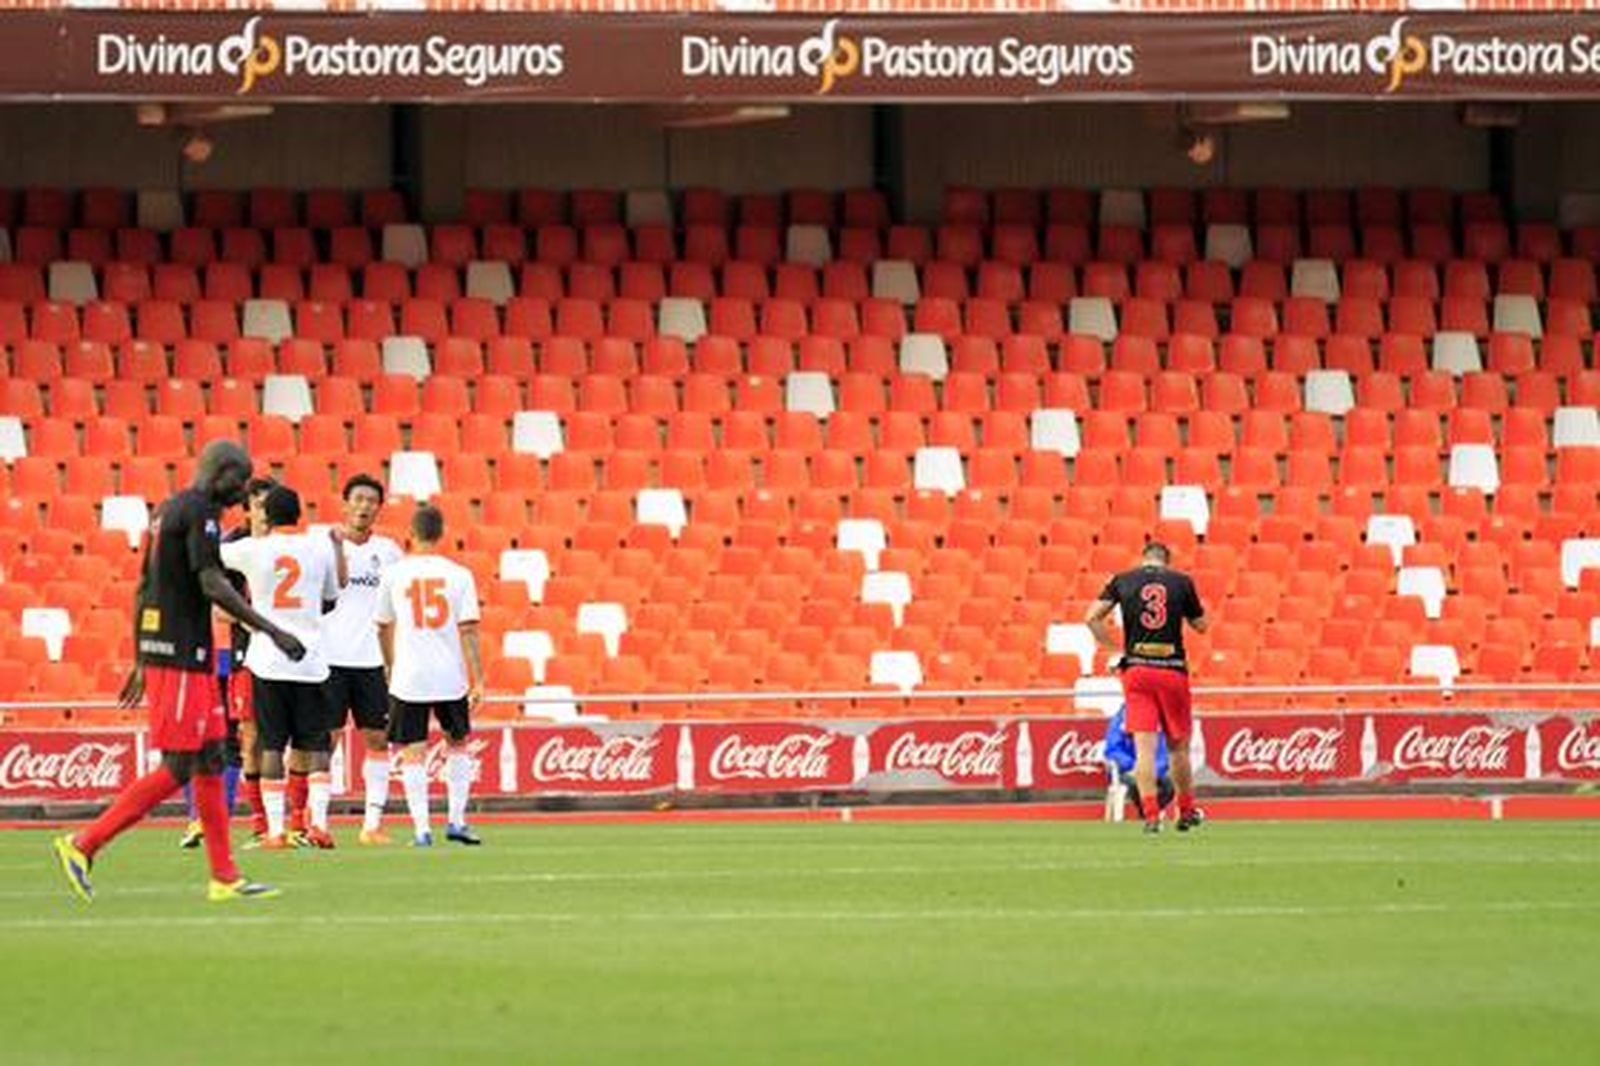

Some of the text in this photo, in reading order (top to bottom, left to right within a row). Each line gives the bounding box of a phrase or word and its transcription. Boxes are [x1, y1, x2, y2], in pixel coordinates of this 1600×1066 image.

[98, 34, 213, 75] Divina
[285, 35, 421, 76] Pastora
[425, 36, 564, 86] Seguros
[682, 36, 794, 77] Divina
[862, 37, 994, 78] Pastora
[999, 37, 1134, 86] Seguros
[1250, 35, 1361, 76] Divina
[1431, 35, 1564, 75] Pastora
[272, 554, 302, 610] 2
[405, 577, 450, 630] 15
[1140, 583, 1167, 630] 3
